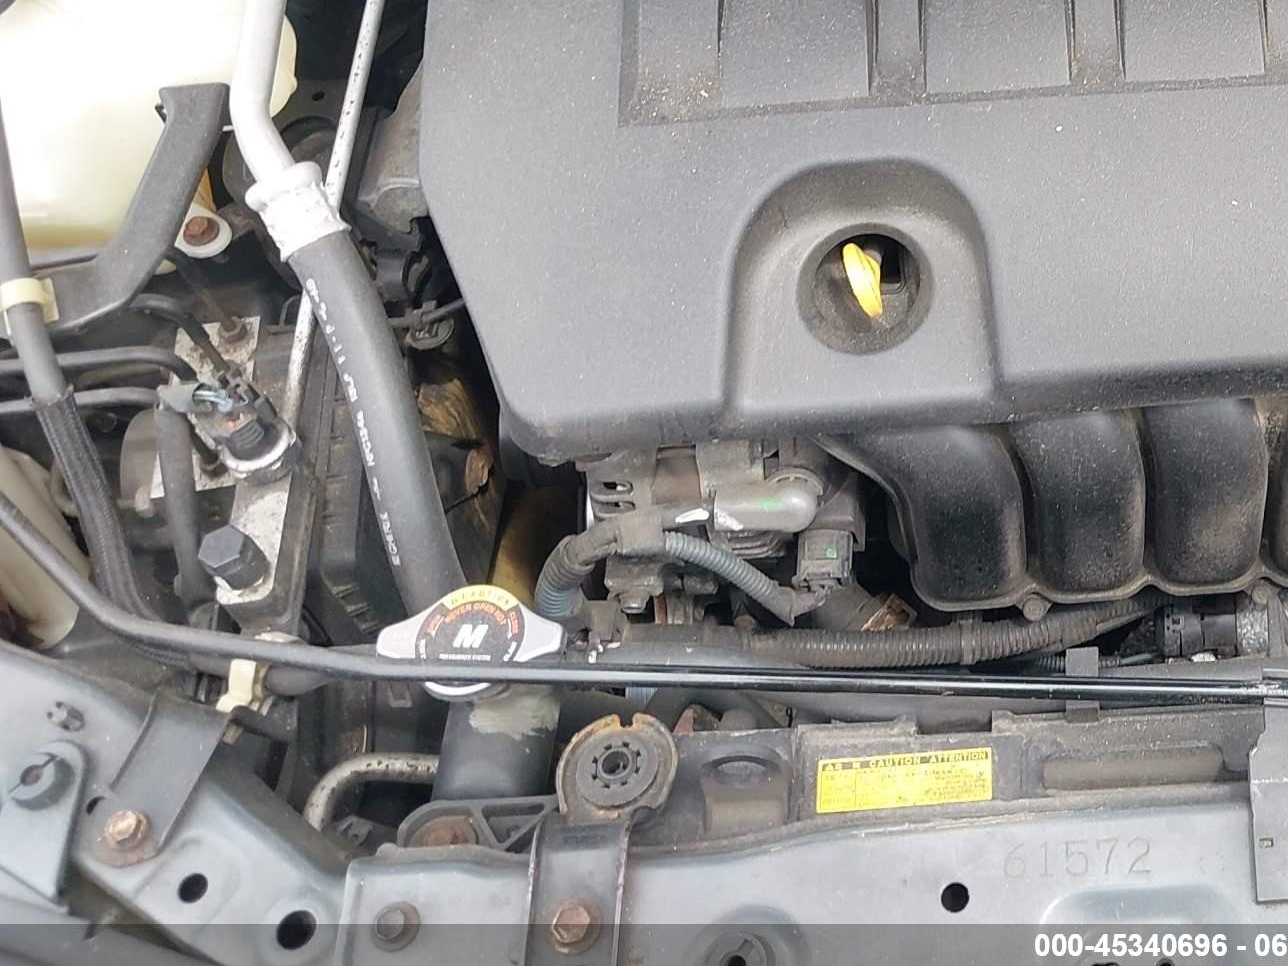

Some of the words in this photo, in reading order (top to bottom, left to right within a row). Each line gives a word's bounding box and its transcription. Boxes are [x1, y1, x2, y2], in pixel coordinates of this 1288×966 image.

[444, 603, 472, 624] NEVER
[473, 602, 496, 616] OPEN
[452, 624, 489, 648] M
[869, 757, 921, 769] CAUTION
[928, 752, 988, 764] ATTENTION
[1003, 837, 1152, 878] 61572
